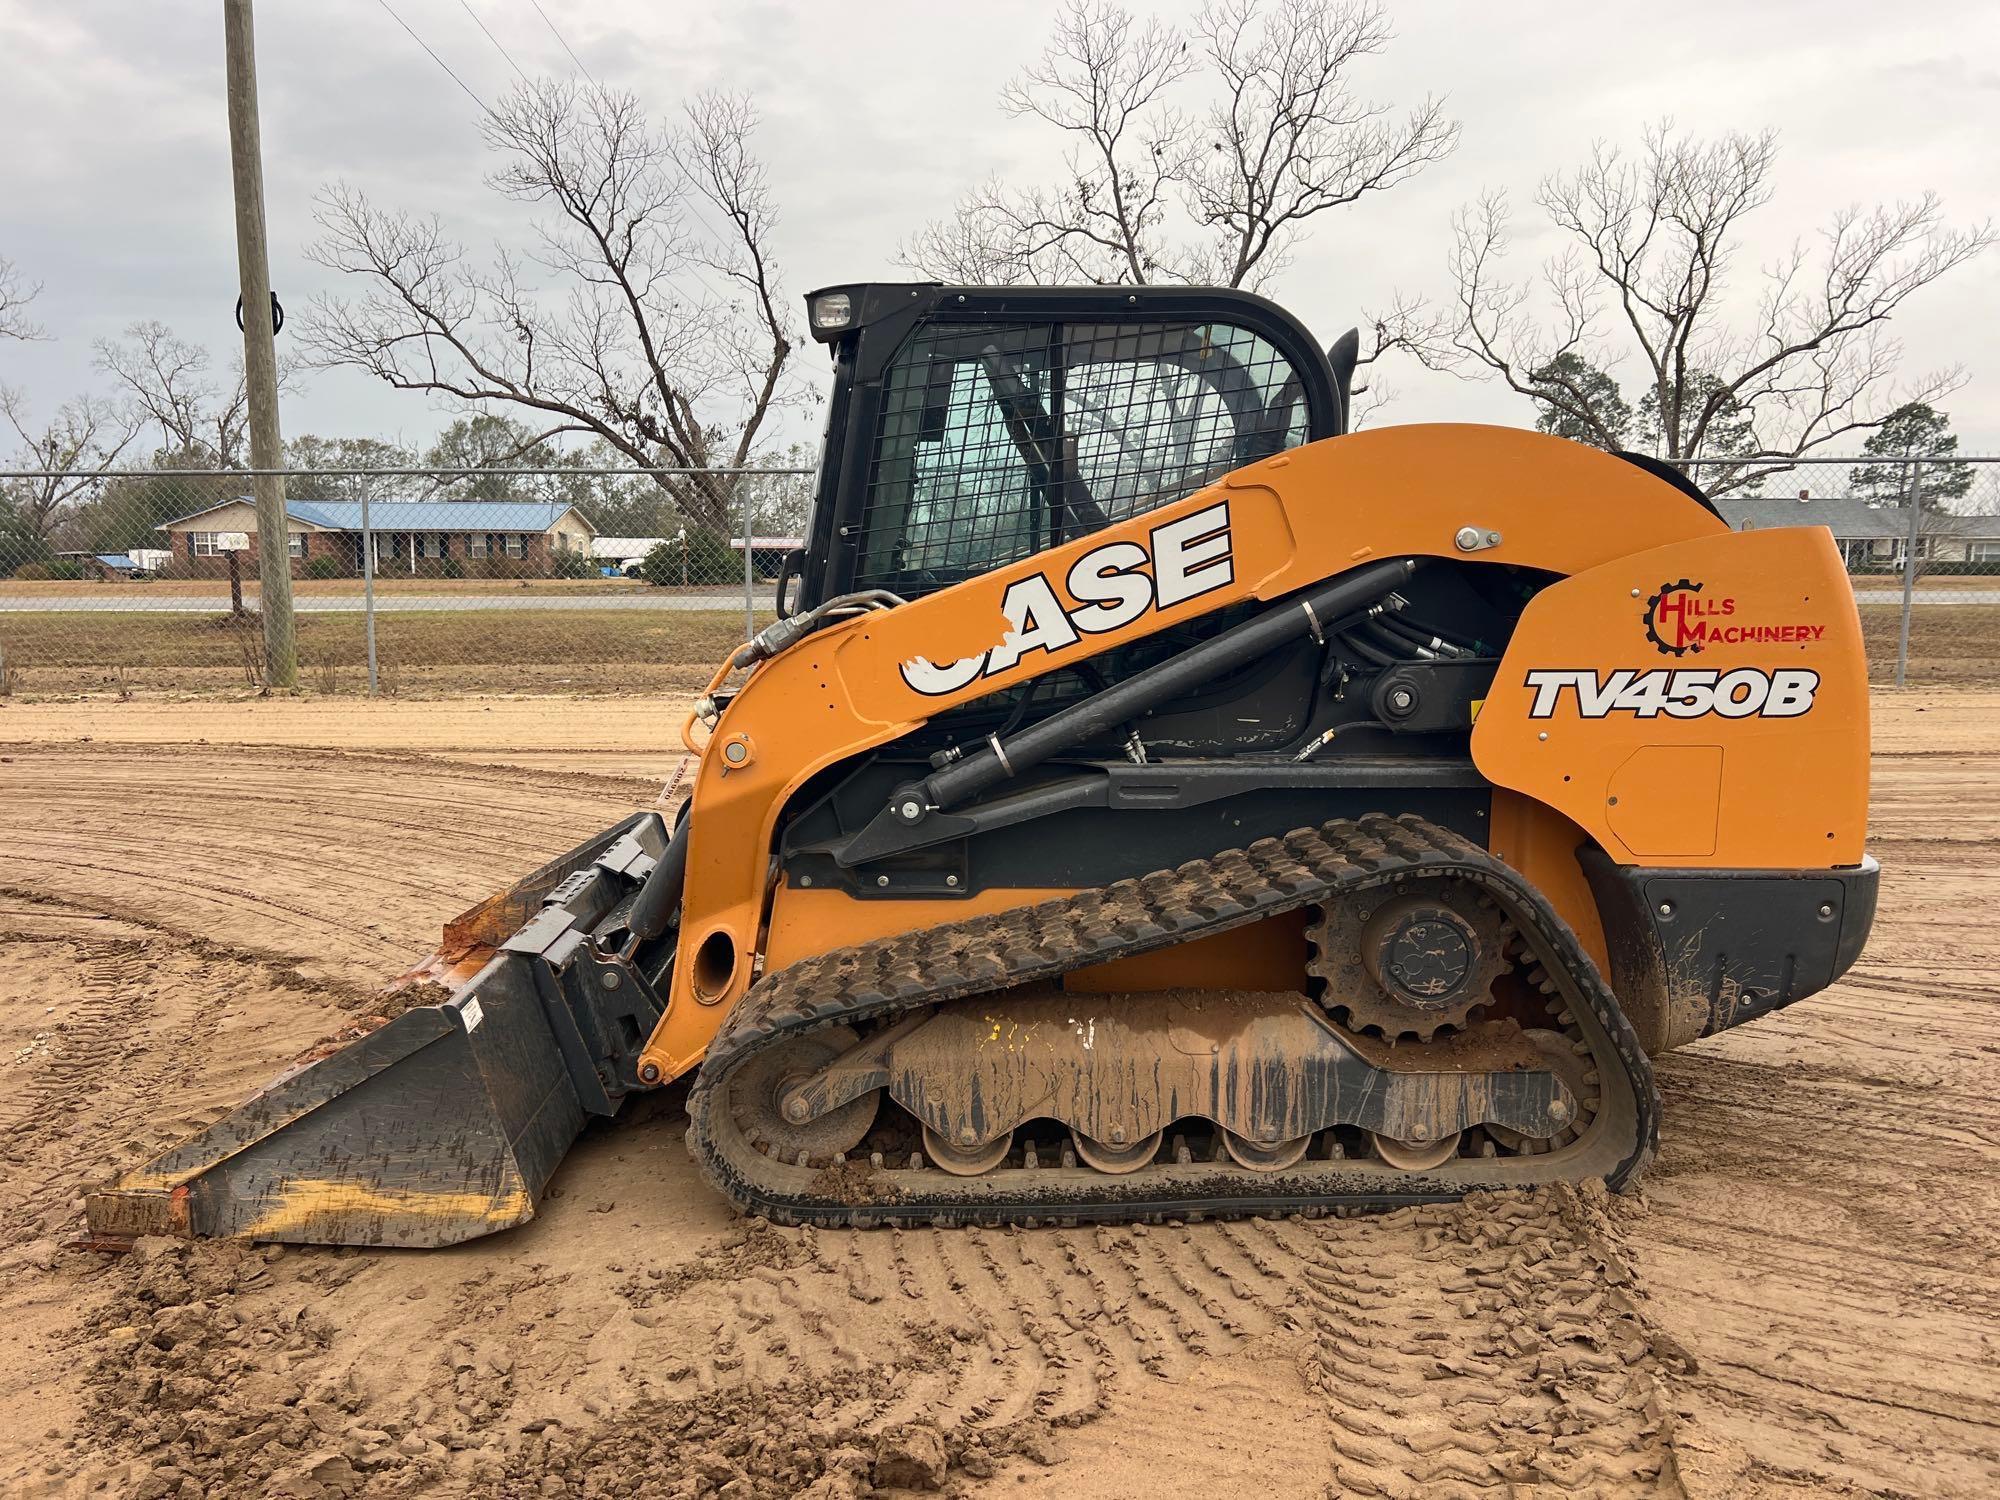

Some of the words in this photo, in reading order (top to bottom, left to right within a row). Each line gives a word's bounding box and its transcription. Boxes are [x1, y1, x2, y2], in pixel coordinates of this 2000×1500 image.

[1659, 593, 1735, 623] HILLS
[1676, 621, 1826, 650] MACHINERY
[1523, 667, 1820, 719] TV450B
